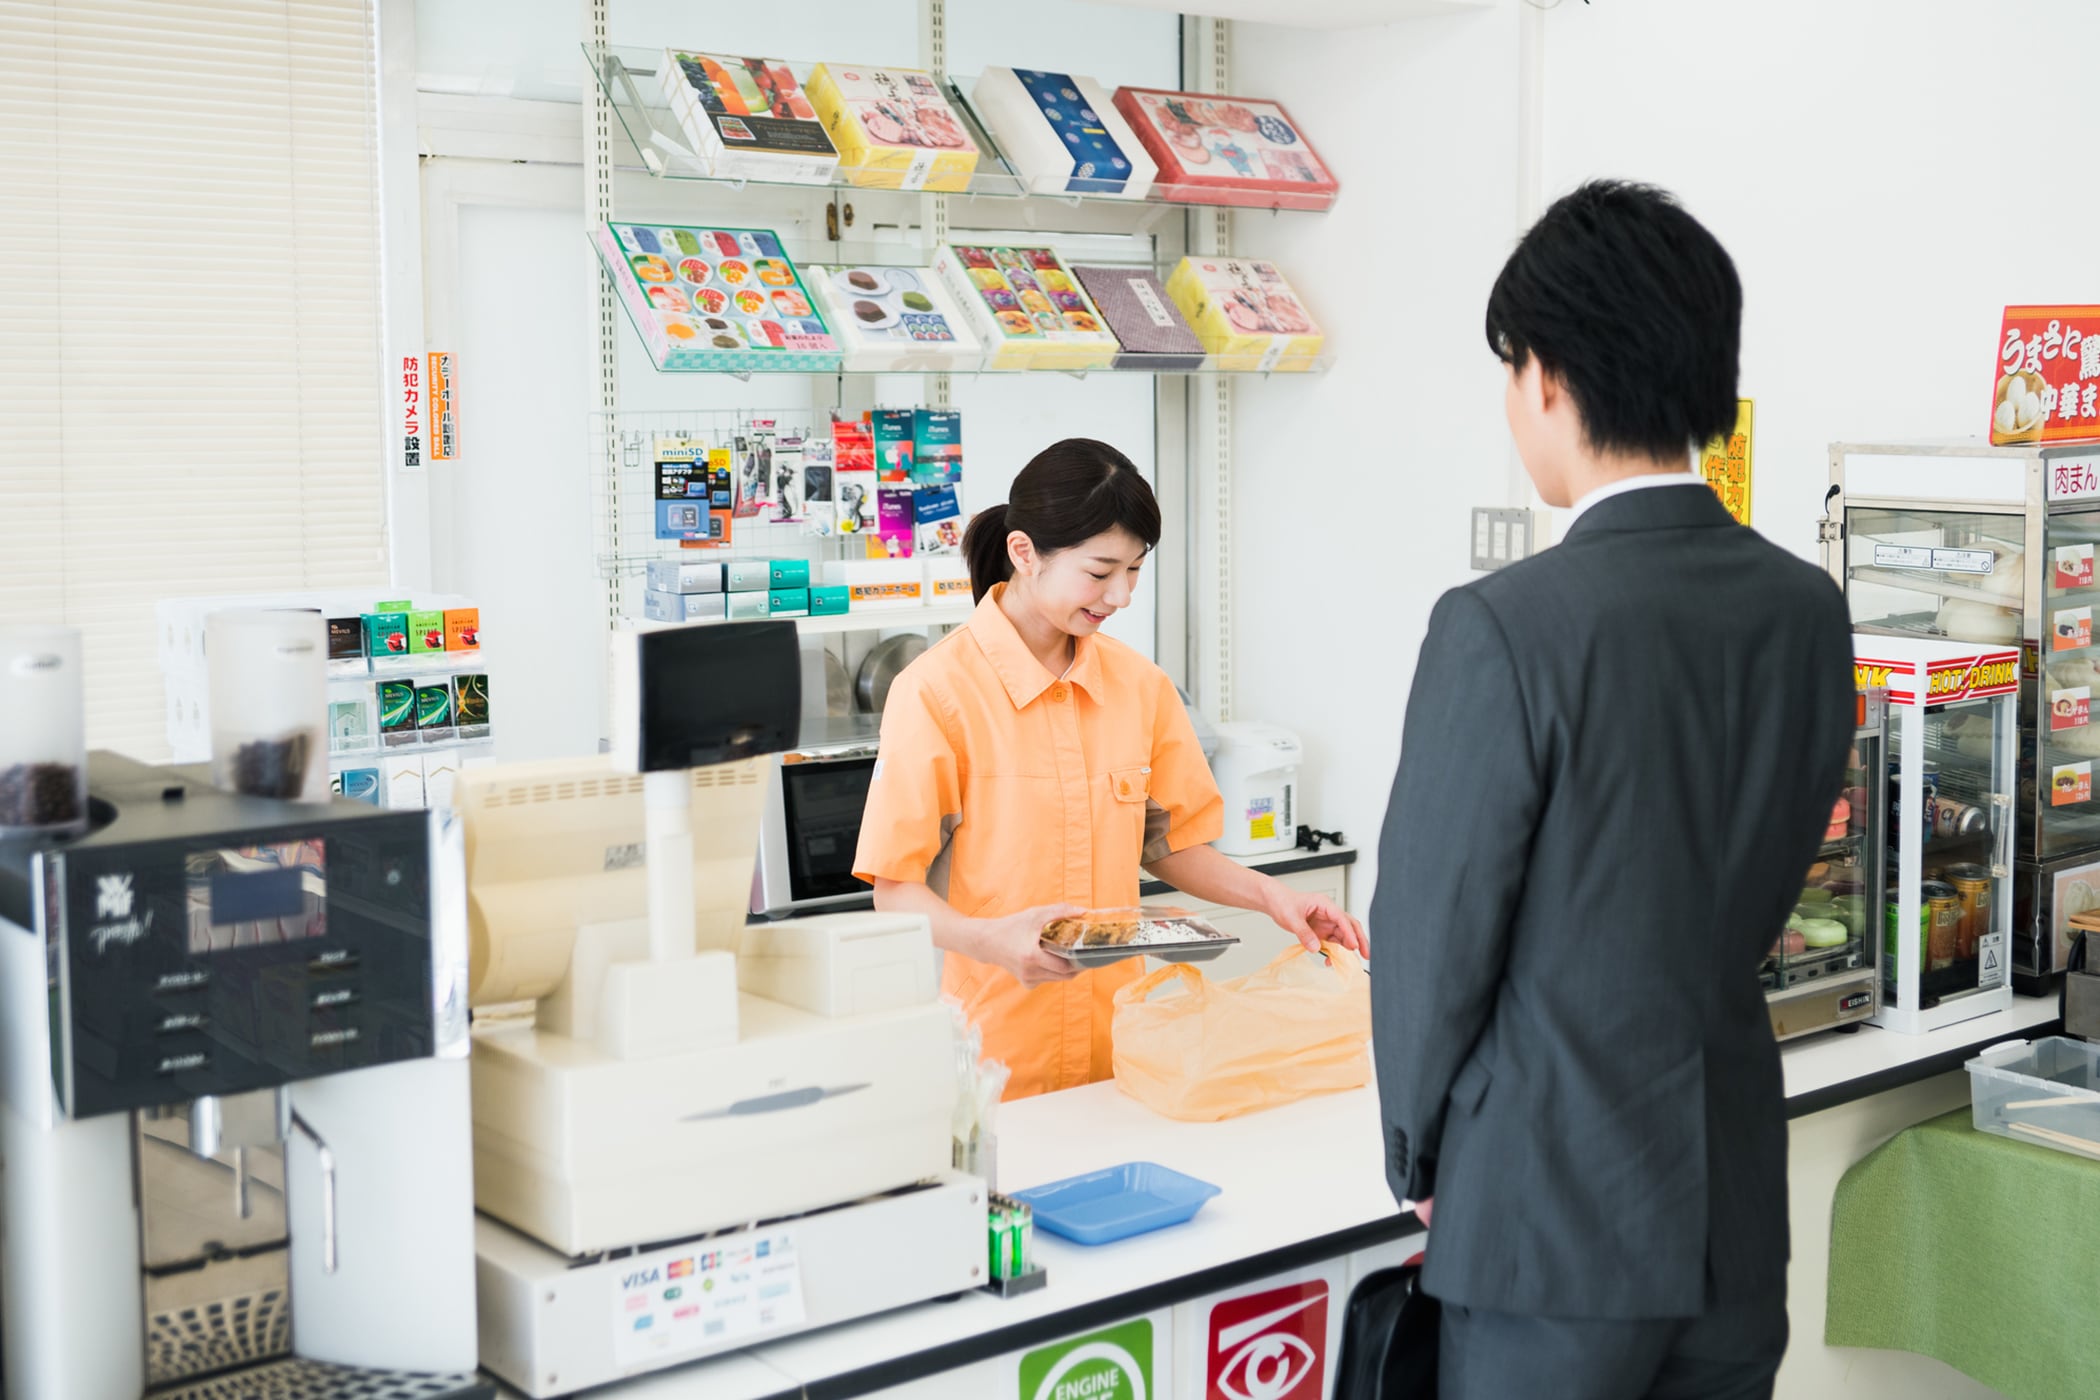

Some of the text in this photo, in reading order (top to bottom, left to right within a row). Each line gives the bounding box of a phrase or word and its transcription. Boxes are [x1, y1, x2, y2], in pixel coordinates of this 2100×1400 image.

[403, 357, 420, 466] 防犯カメラ設置
[2041, 383, 2100, 421] 中華ま
[662, 448, 704, 456] miniSD
[2055, 463, 2098, 495] 肉まん
[1854, 664, 1894, 691] NK
[1929, 661, 2017, 695] HOT! DRINK
[623, 1267, 661, 1289] VISA
[1056, 1367, 1119, 1400] ENGINE
